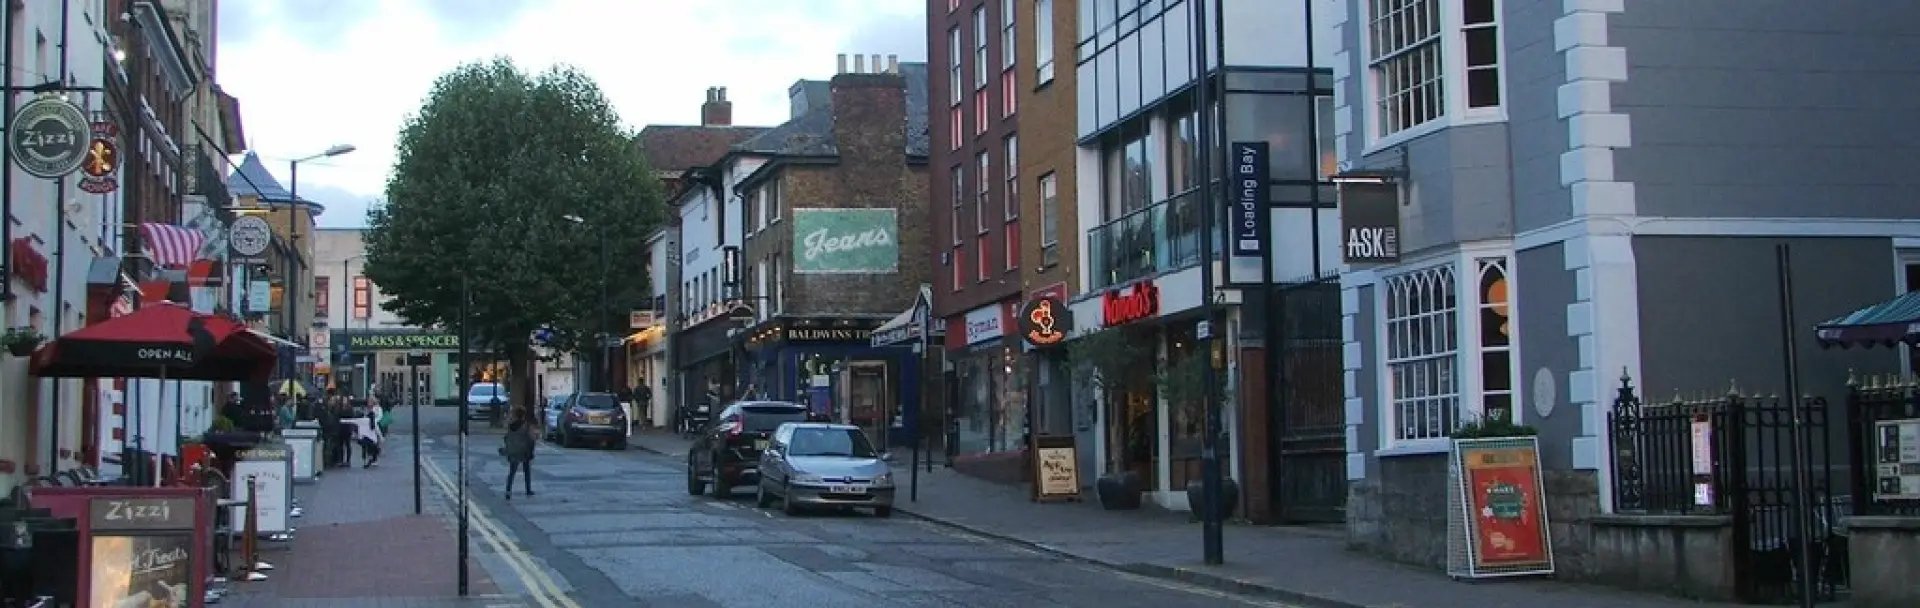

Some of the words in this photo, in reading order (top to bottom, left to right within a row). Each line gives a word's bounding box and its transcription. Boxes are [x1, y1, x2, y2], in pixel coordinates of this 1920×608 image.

[21, 130, 76, 147] Zizzi
[1241, 146, 1257, 174] Bay
[1241, 179, 1257, 238] Loading
[1347, 227, 1384, 257] ASK
[351, 335, 394, 347] MARKS
[406, 335, 460, 347] SPENCER
[788, 329, 852, 340] BALDWINS
[138, 348, 172, 359] OPEN
[104, 500, 170, 520] Zizzi
